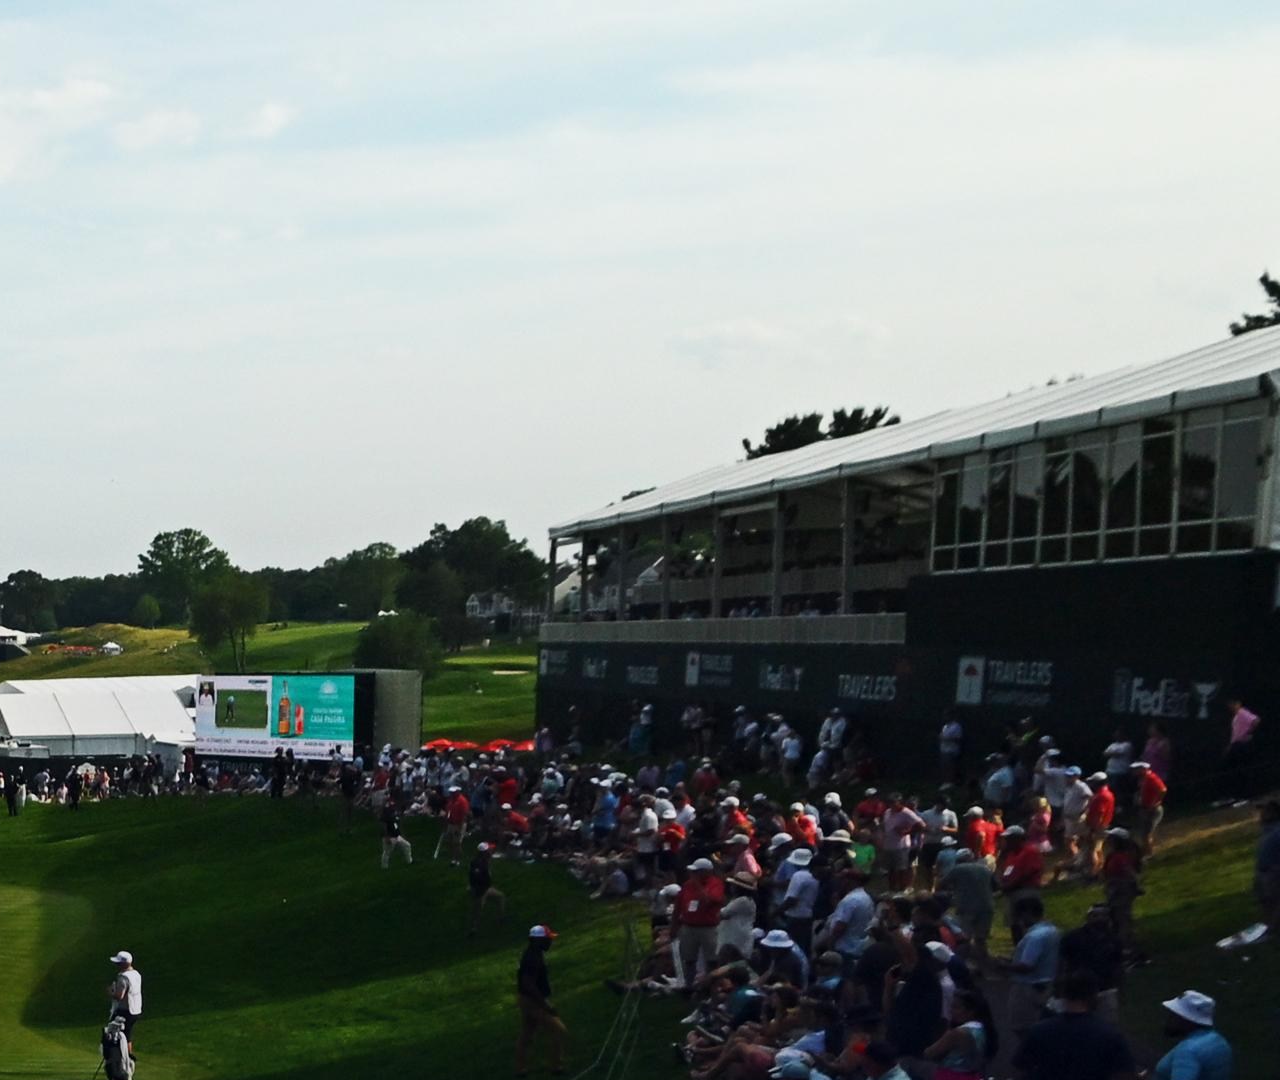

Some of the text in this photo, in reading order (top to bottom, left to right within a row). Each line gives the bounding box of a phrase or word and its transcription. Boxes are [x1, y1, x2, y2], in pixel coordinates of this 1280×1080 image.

[838, 673, 897, 701] TRAVELERS
[989, 660, 1054, 686] TRAVELERS
[1130, 676, 1189, 718] FedEx
